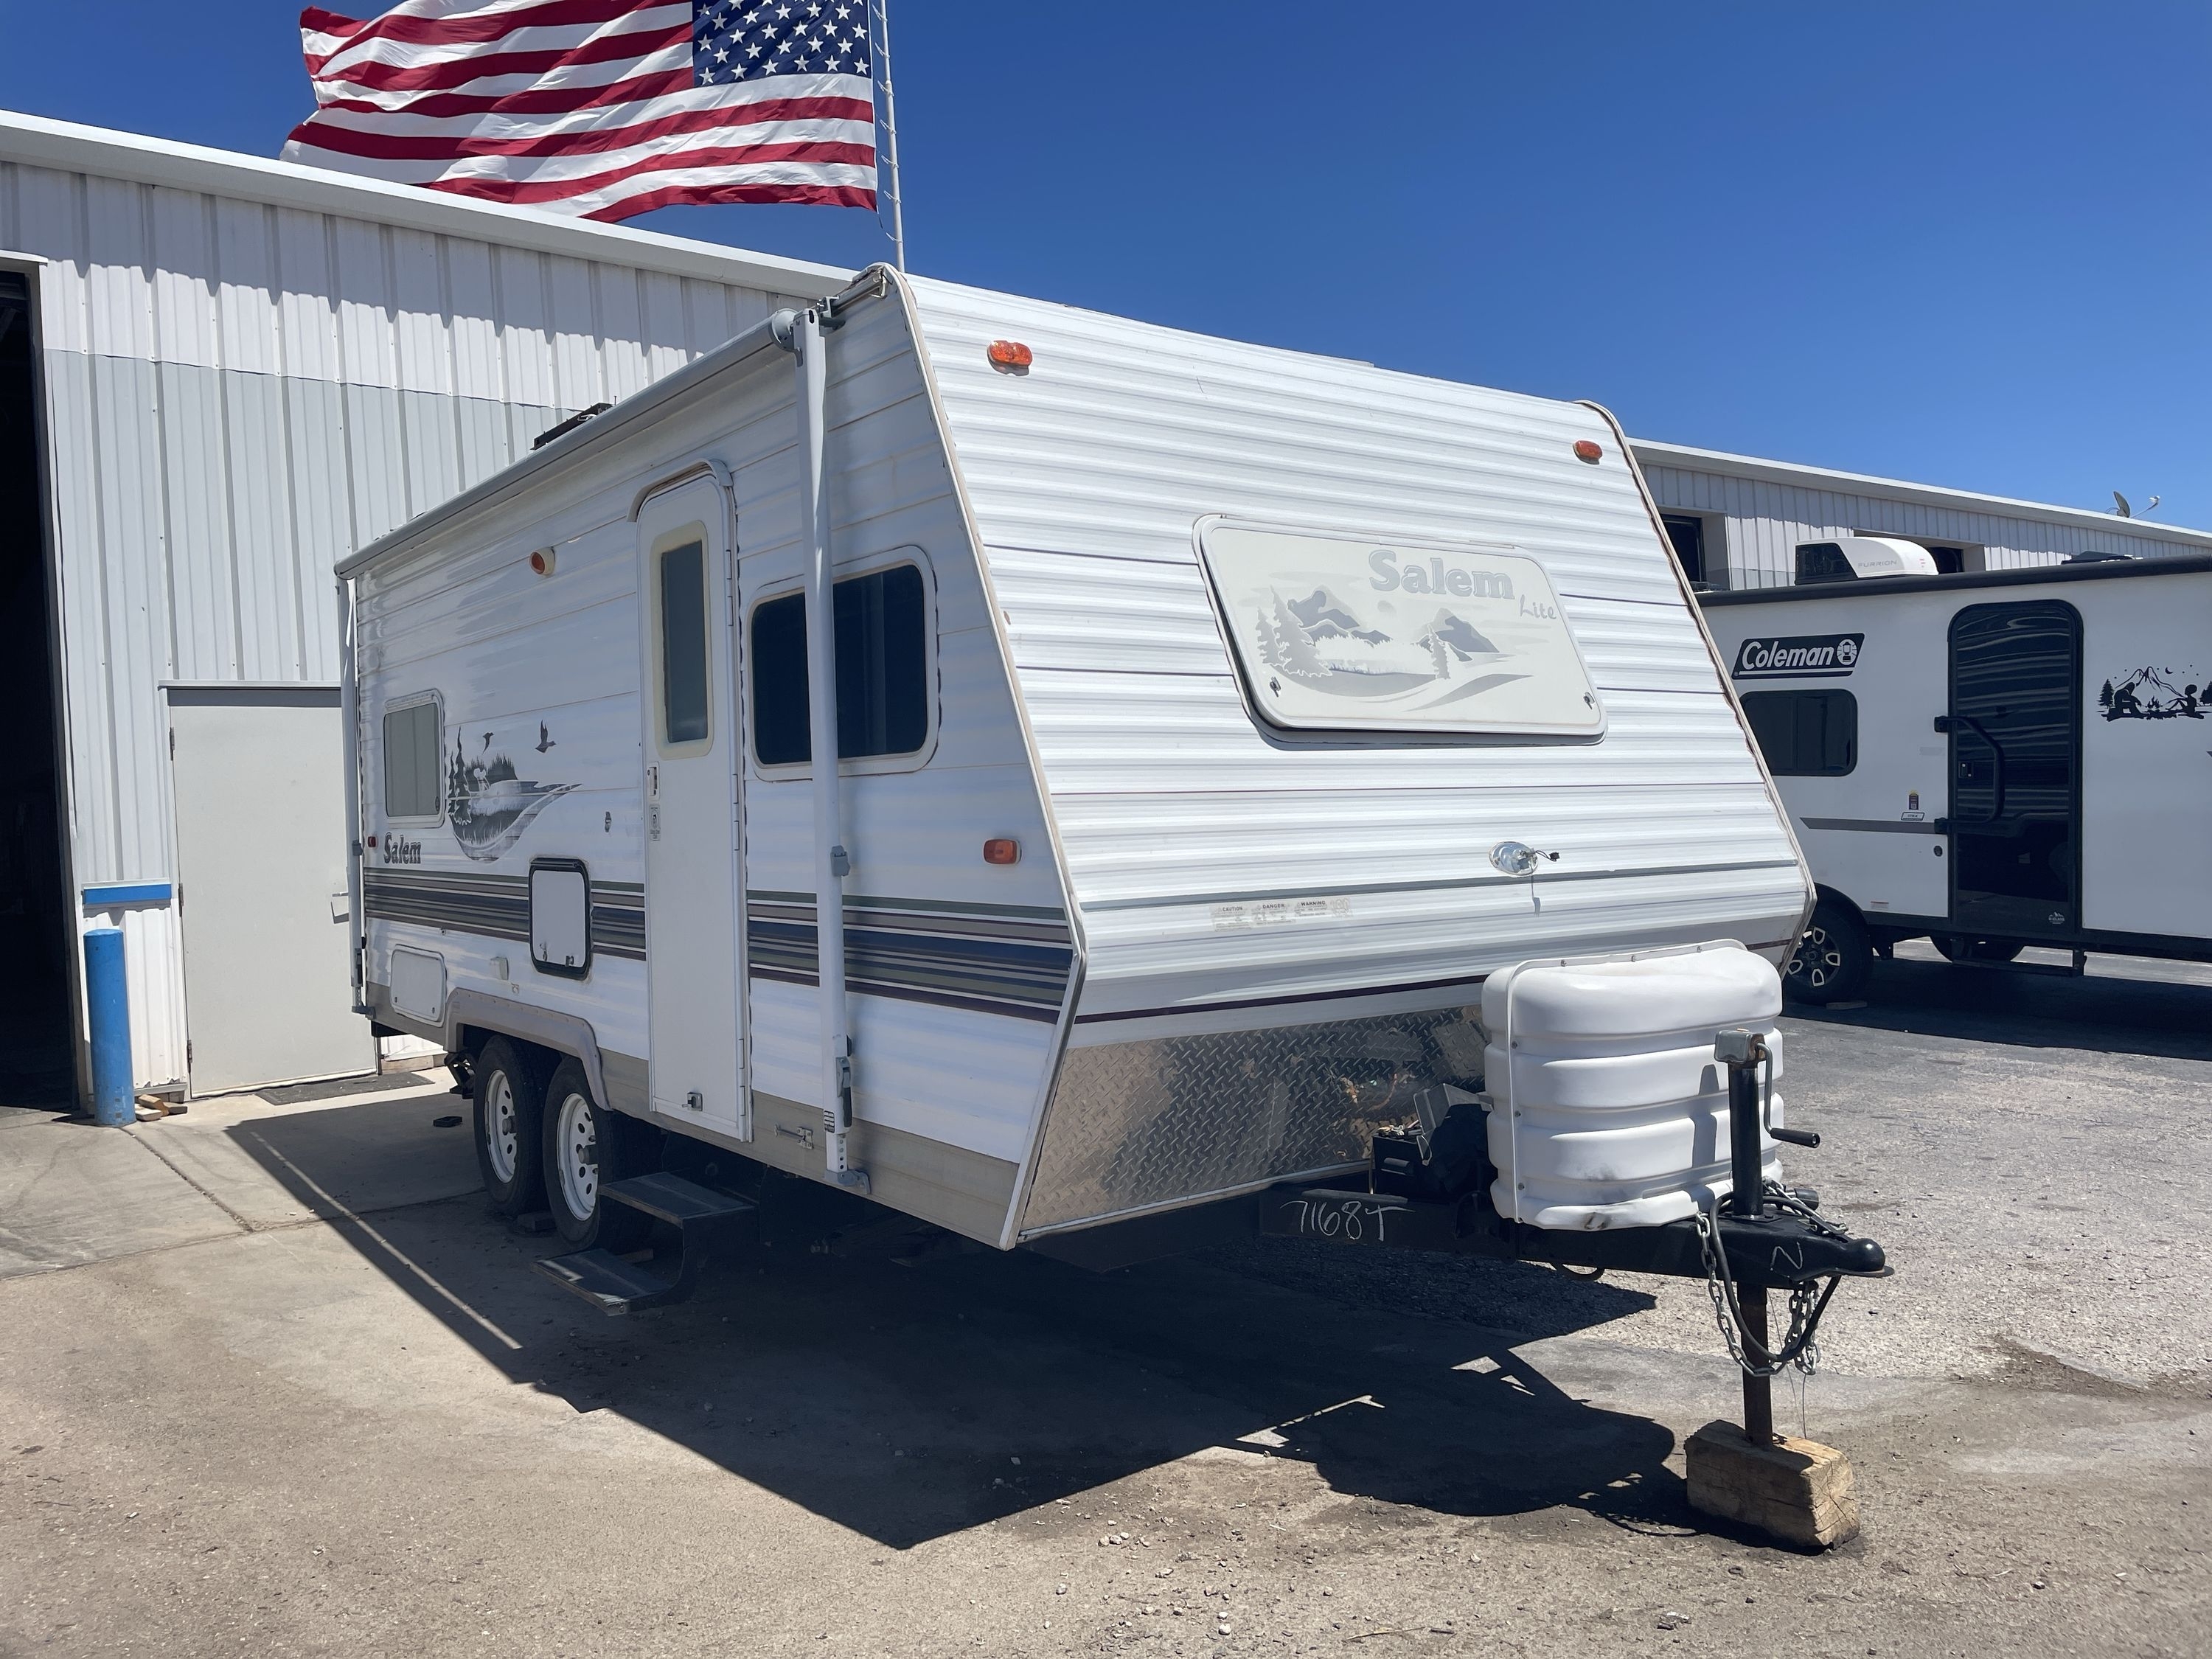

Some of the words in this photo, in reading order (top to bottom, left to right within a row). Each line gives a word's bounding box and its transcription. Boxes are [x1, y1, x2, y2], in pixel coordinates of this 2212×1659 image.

[1368, 549, 1515, 600] Salem
[1857, 560, 1897, 568] FURRION
[1520, 594, 1557, 620] Lite
[1742, 641, 1835, 670] Coleman
[383, 832, 422, 864] Salem
[1279, 1200, 1416, 1242] 7168T
